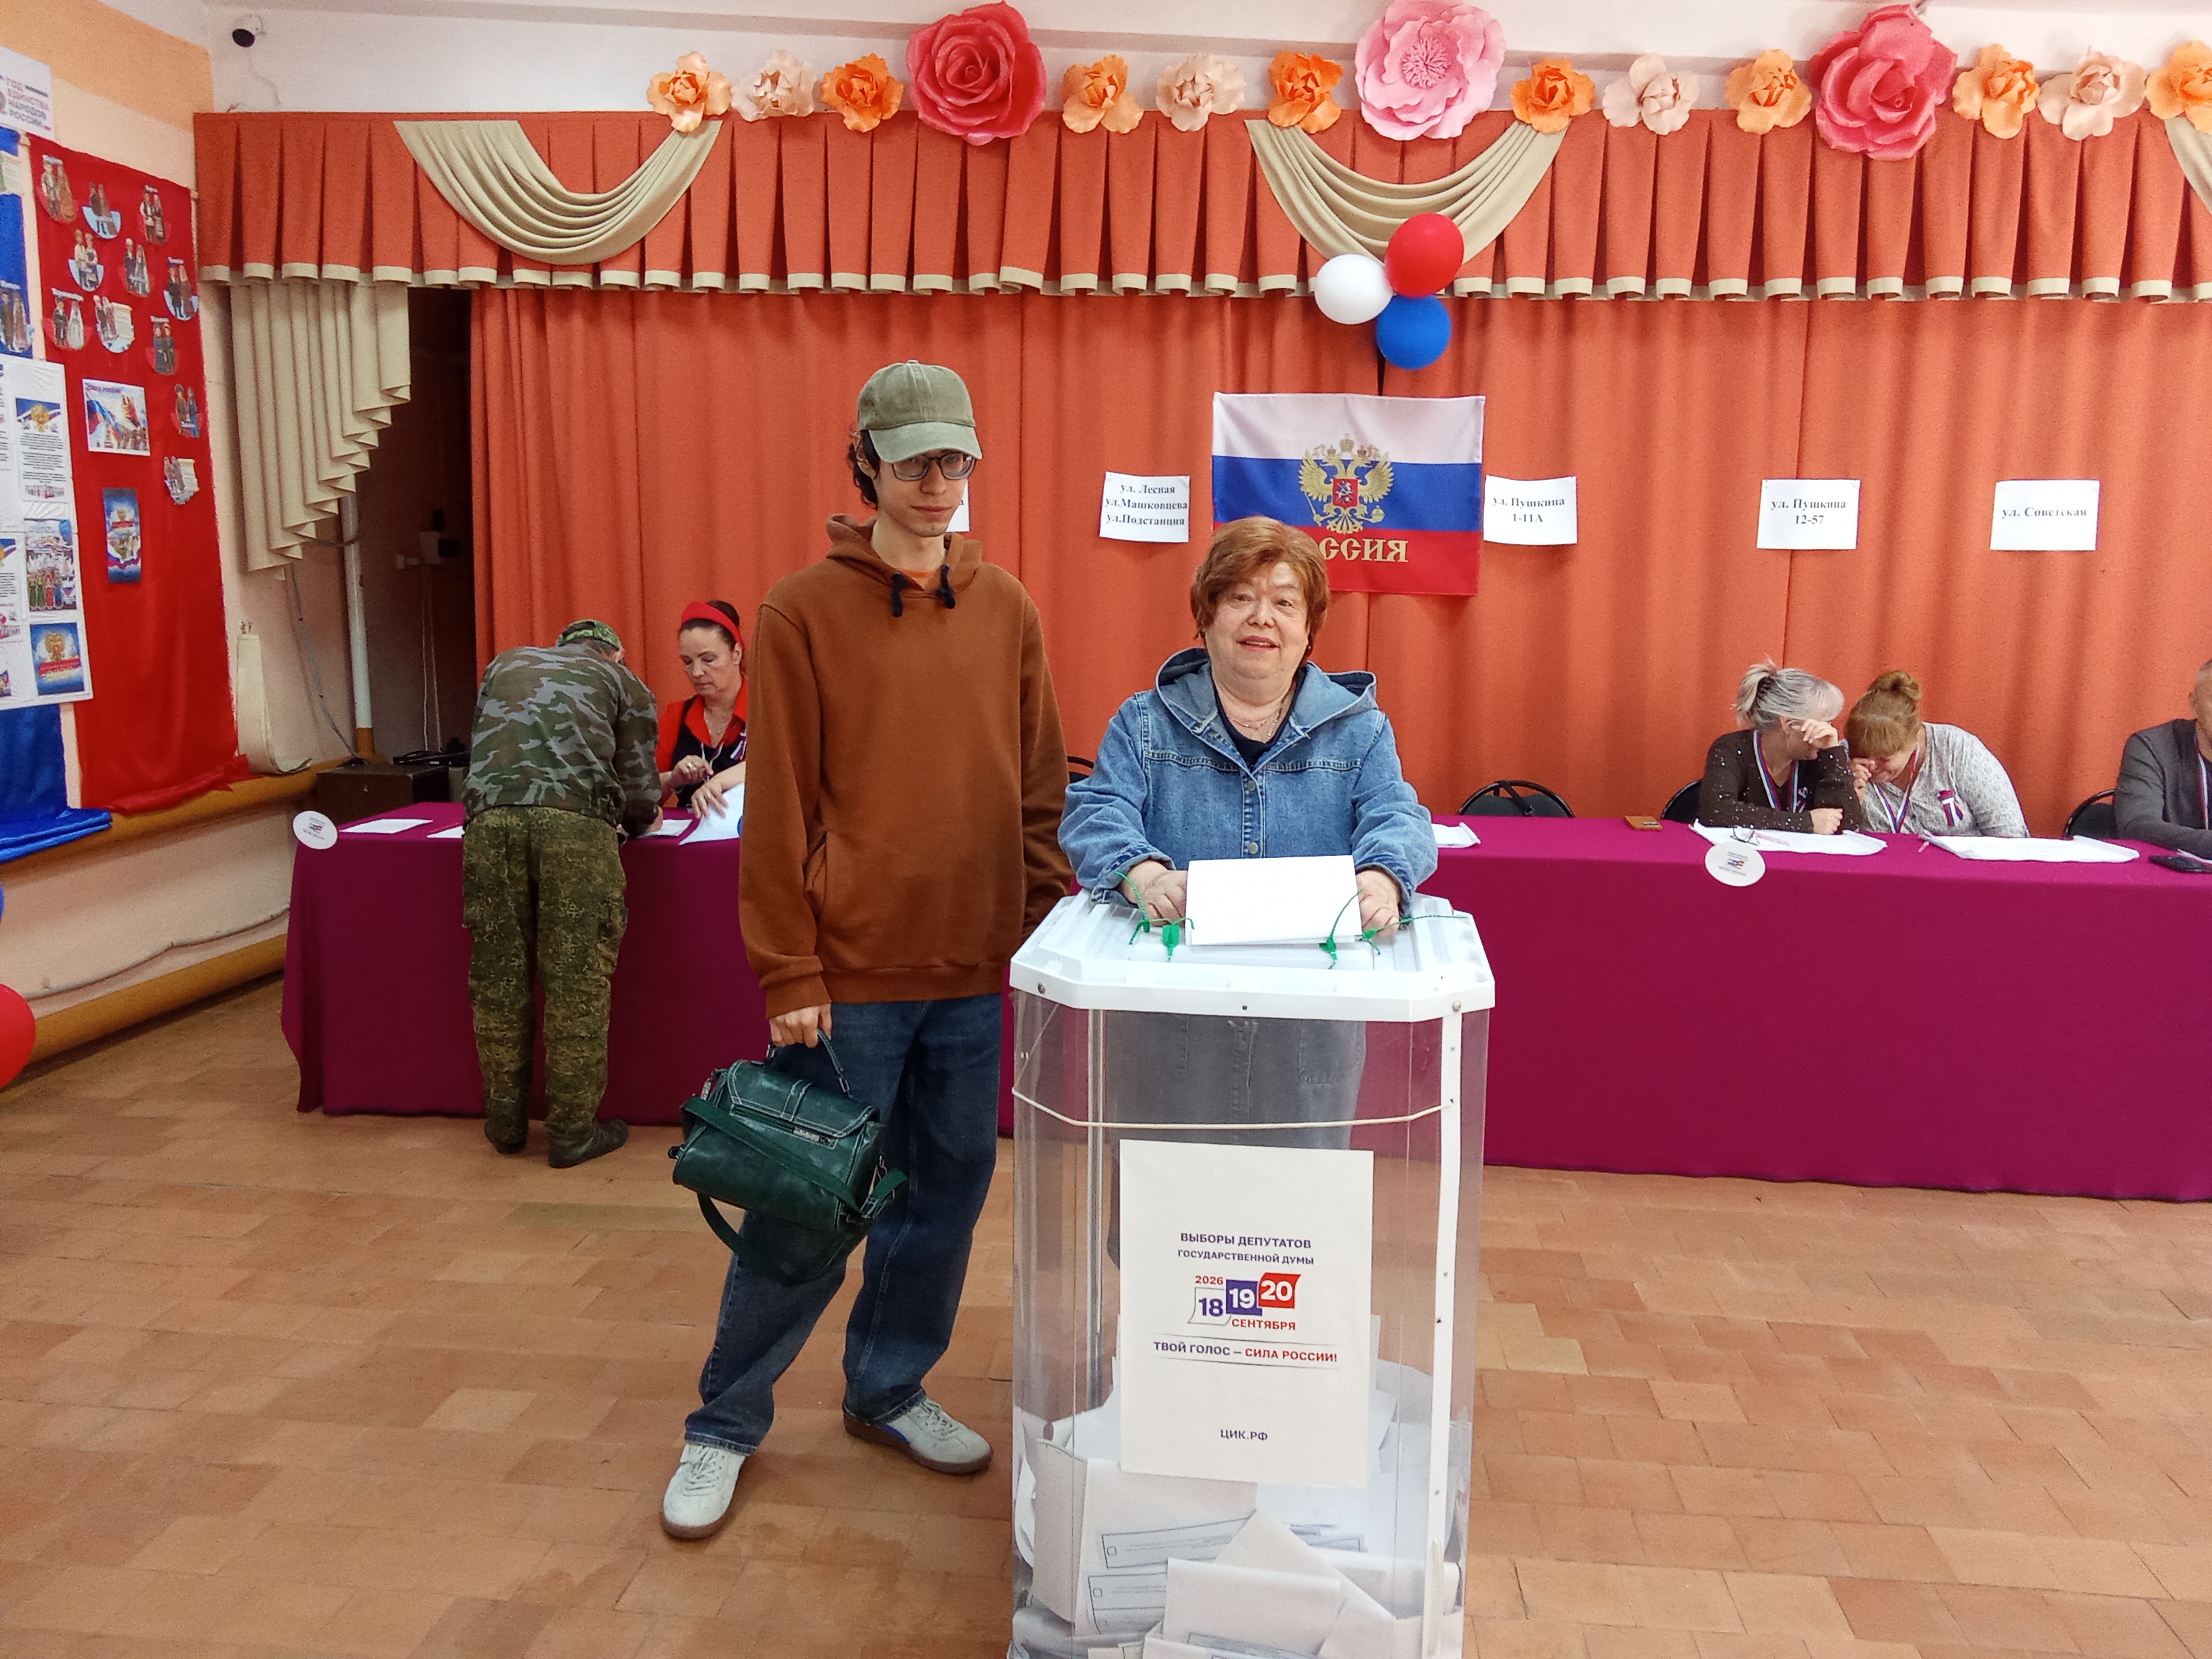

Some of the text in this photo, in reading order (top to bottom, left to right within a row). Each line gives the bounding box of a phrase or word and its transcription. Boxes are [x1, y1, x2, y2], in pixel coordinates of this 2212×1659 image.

[1120, 485, 1175, 494] ул. Лесная
[1105, 498, 1187, 510] ул.Машковцева
[1492, 497, 1565, 510] ул. Пушкина
[1770, 499, 1846, 511] ул. Пушкина
[1513, 513, 1543, 523] 1-11А
[1795, 514, 1824, 525] 12-57
[2001, 507, 2087, 520] ул. Советская
[1106, 514, 1185, 526] ул.Подстанция
[1319, 536, 1408, 563] ССИЯ
[1181, 1233, 1311, 1249] ВЫБОРЫ ДЕПУТАТОВ
[1178, 1250, 1314, 1265] ГОСУДАРСТВЕННОЙ ДУМЫ
[1195, 1275, 1224, 1285] 2026
[1199, 1279, 1293, 1317] 18 19 20
[1231, 1318, 1296, 1330] СЕНТЯБРЯ
[1153, 1341, 1186, 1353] ТВОЙ
[1189, 1345, 1231, 1355] ГОЛОС
[1245, 1348, 1279, 1359] СИЛА
[1282, 1351, 1337, 1362] РОССИИ!
[1220, 1429, 1268, 1441] ЦИК.РФ
